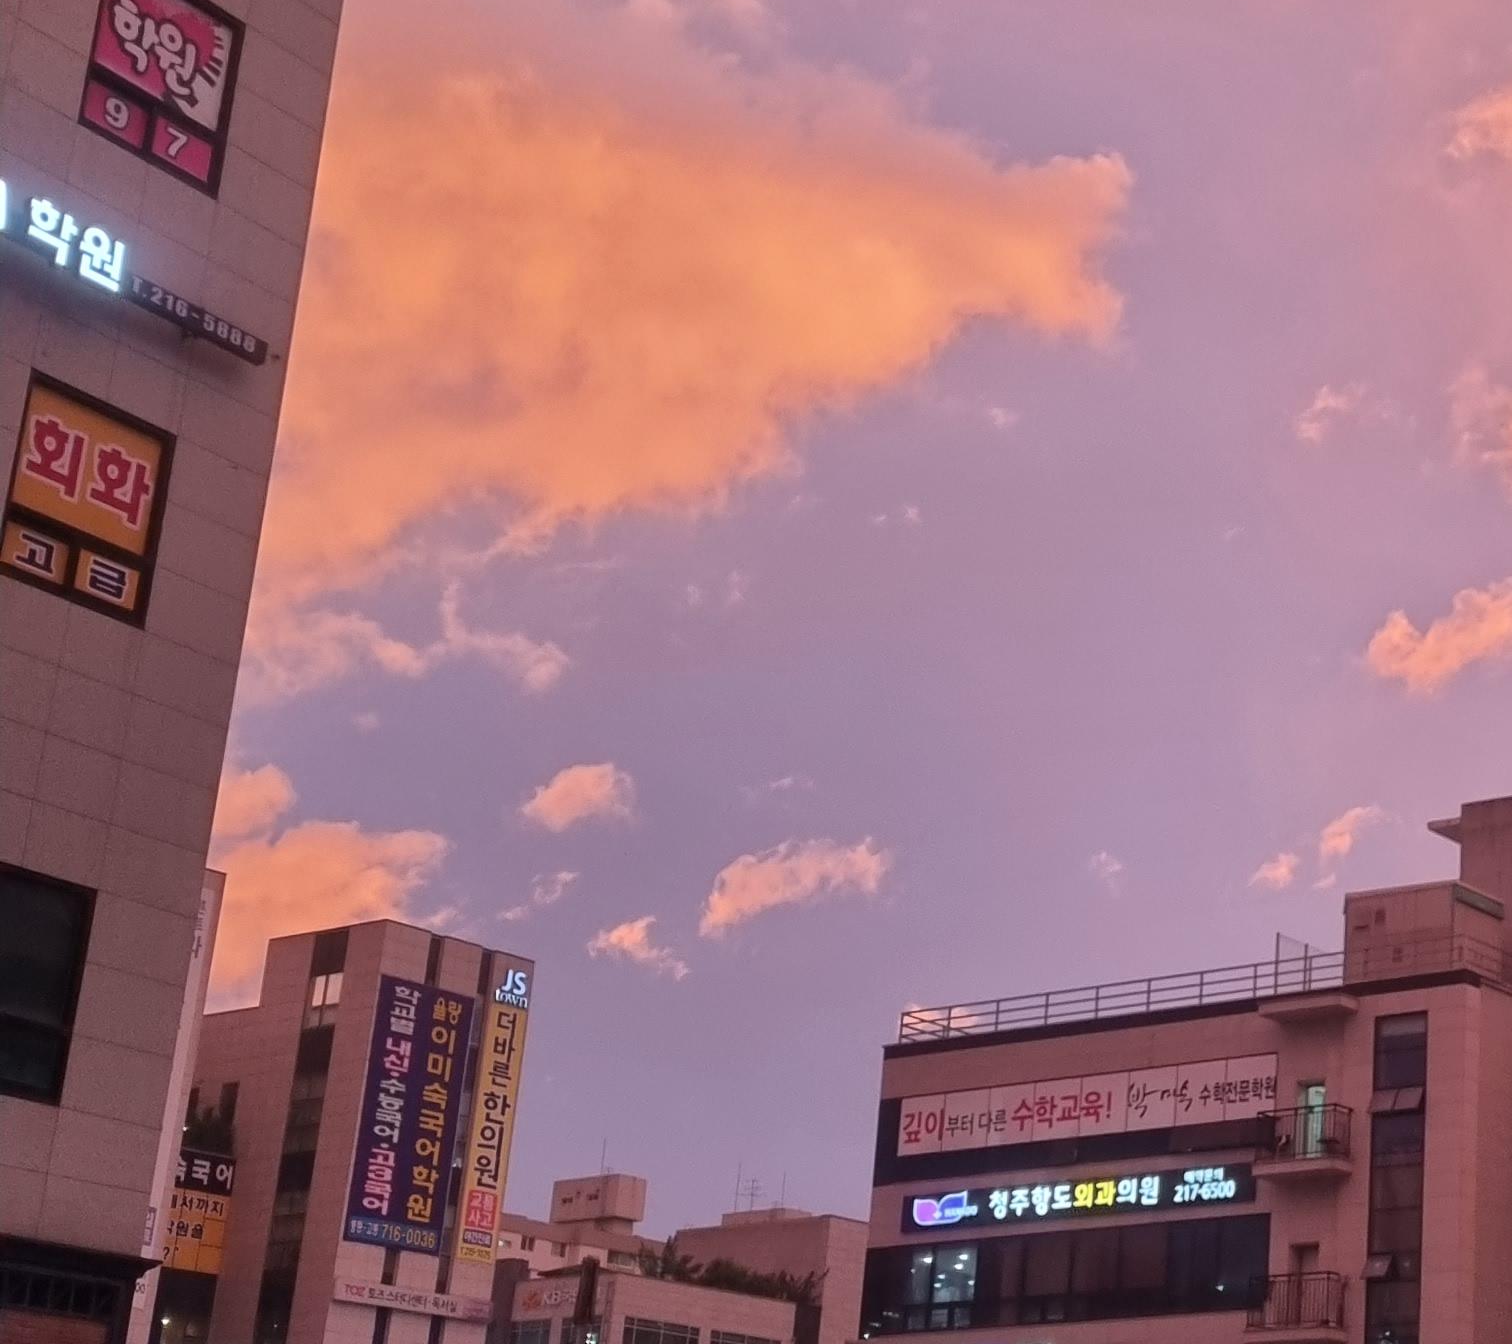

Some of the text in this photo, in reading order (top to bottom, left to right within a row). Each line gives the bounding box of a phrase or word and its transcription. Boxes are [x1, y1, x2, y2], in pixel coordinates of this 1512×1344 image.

[103, 98, 129, 128] 9
[167, 128, 188, 159] 7
[29, 196, 126, 292] 학원
[26, 413, 151, 531] 회화
[495, 989, 528, 1008] town
[502, 969, 527, 995] JS
[474, 1011, 516, 1189] 더바른한의원
[902, 1111, 974, 1143] 깊이부터
[978, 1109, 1006, 1133] 다른
[1011, 1091, 1111, 1130] 수학교육!
[1198, 1076, 1277, 1109] 수학전문학원
[407, 1025, 457, 1222] 이미숙국어학원
[988, 1175, 1160, 1220] 청주항도외과의원
[1173, 1180, 1235, 1203] 217-6500
